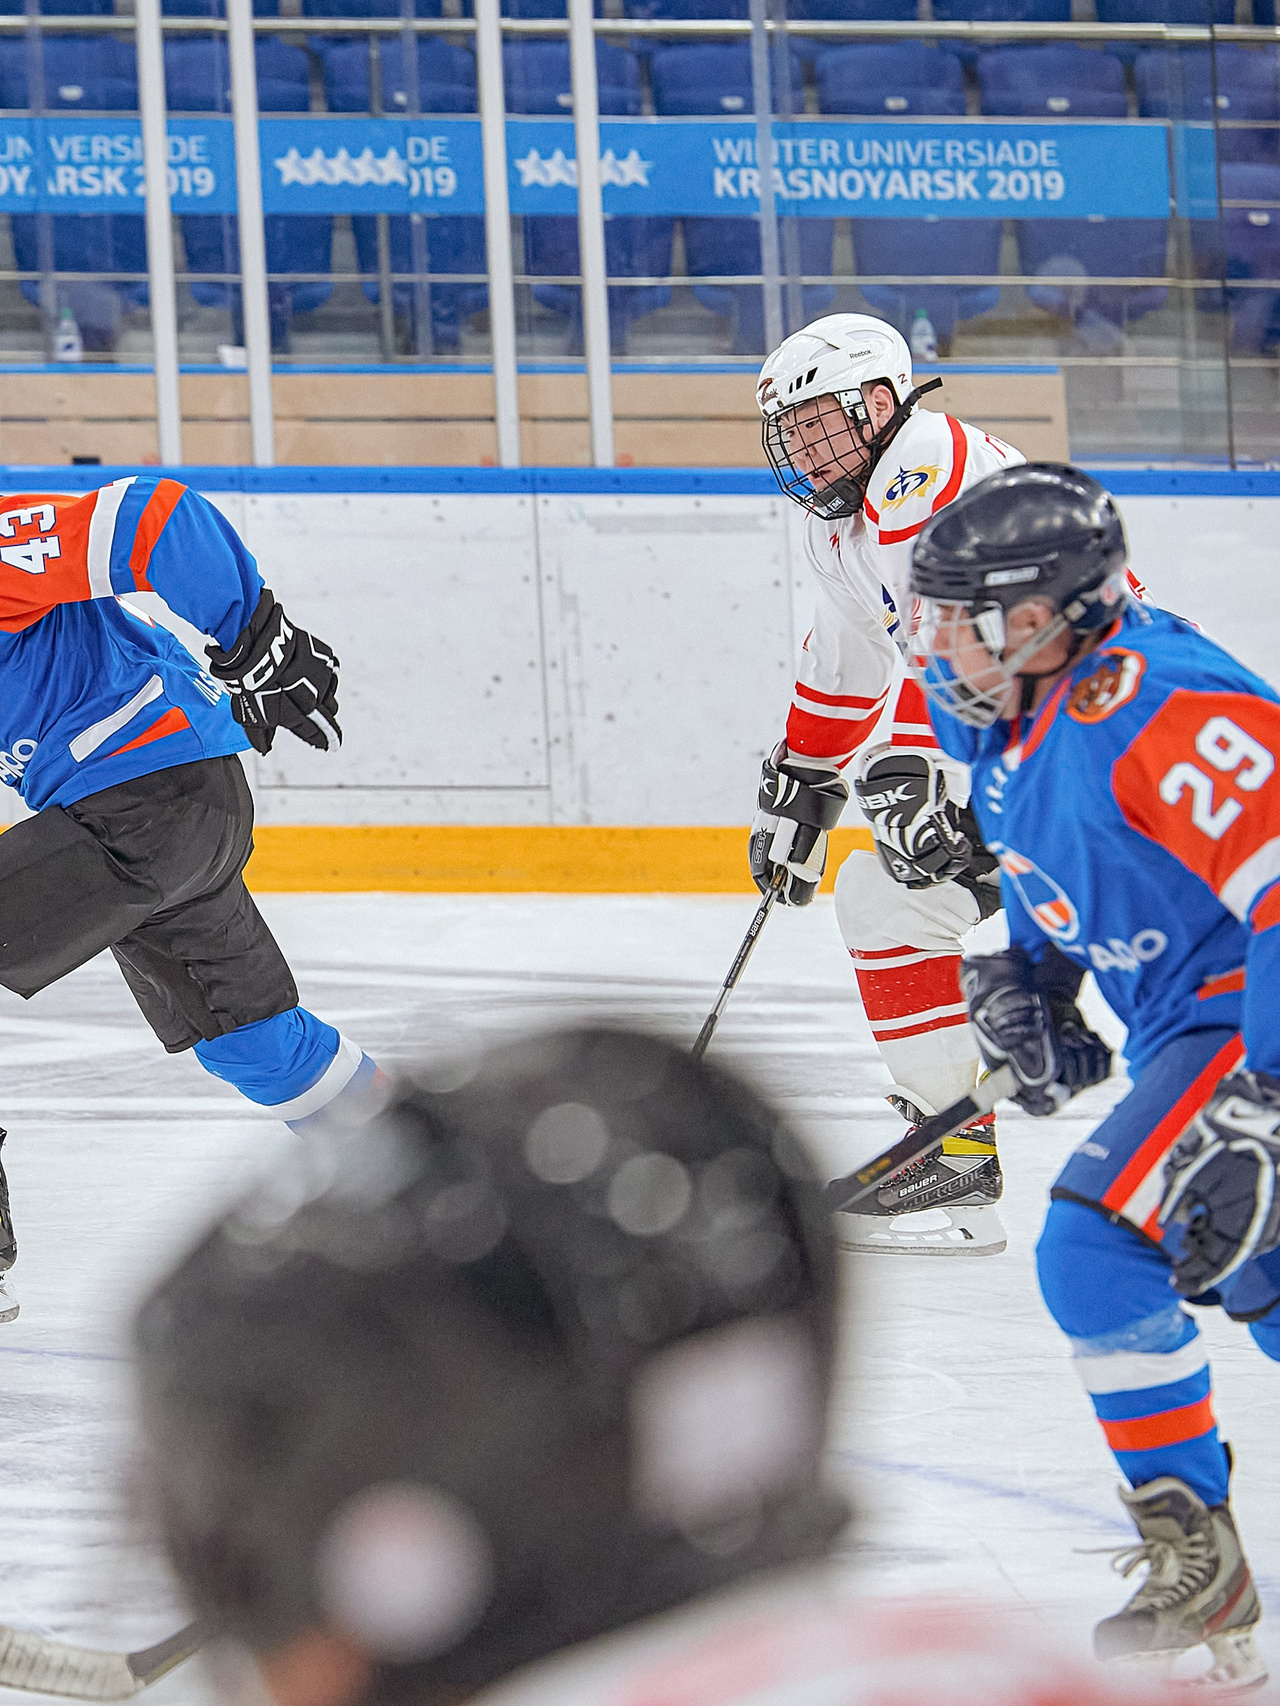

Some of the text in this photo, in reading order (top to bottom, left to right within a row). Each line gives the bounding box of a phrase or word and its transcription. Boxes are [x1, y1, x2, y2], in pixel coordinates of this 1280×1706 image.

[846, 139, 1058, 167] UNIVERSIADE
[714, 168, 1065, 201] KRASNOYARSK 2019
[849, 349, 873, 360] Reebok
[1159, 716, 1276, 841] 29
[749, 911, 765, 937] BAUER
[899, 1174, 938, 1197] BAUER
